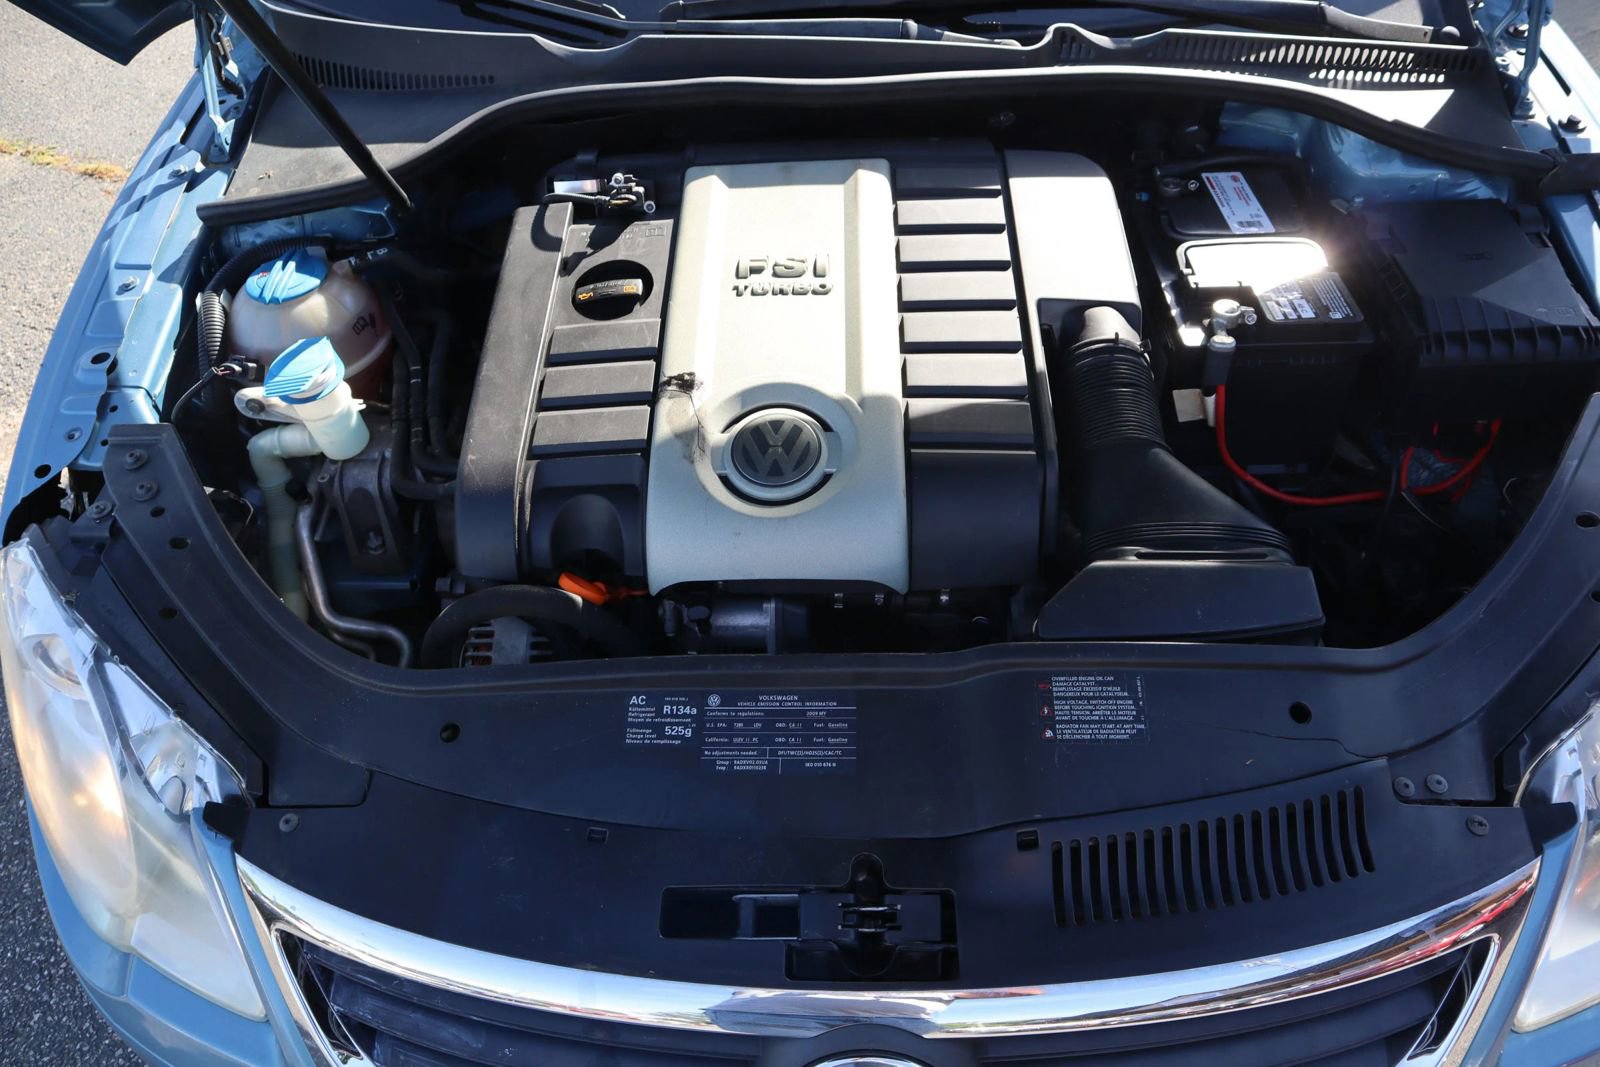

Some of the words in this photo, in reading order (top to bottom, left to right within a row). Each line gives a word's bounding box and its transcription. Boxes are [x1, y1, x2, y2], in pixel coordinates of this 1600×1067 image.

[735, 255, 830, 280] FSI
[732, 282, 833, 297] TURBO
[630, 696, 646, 705] AC
[663, 705, 697, 714] R134a
[665, 726, 692, 737] 525g
